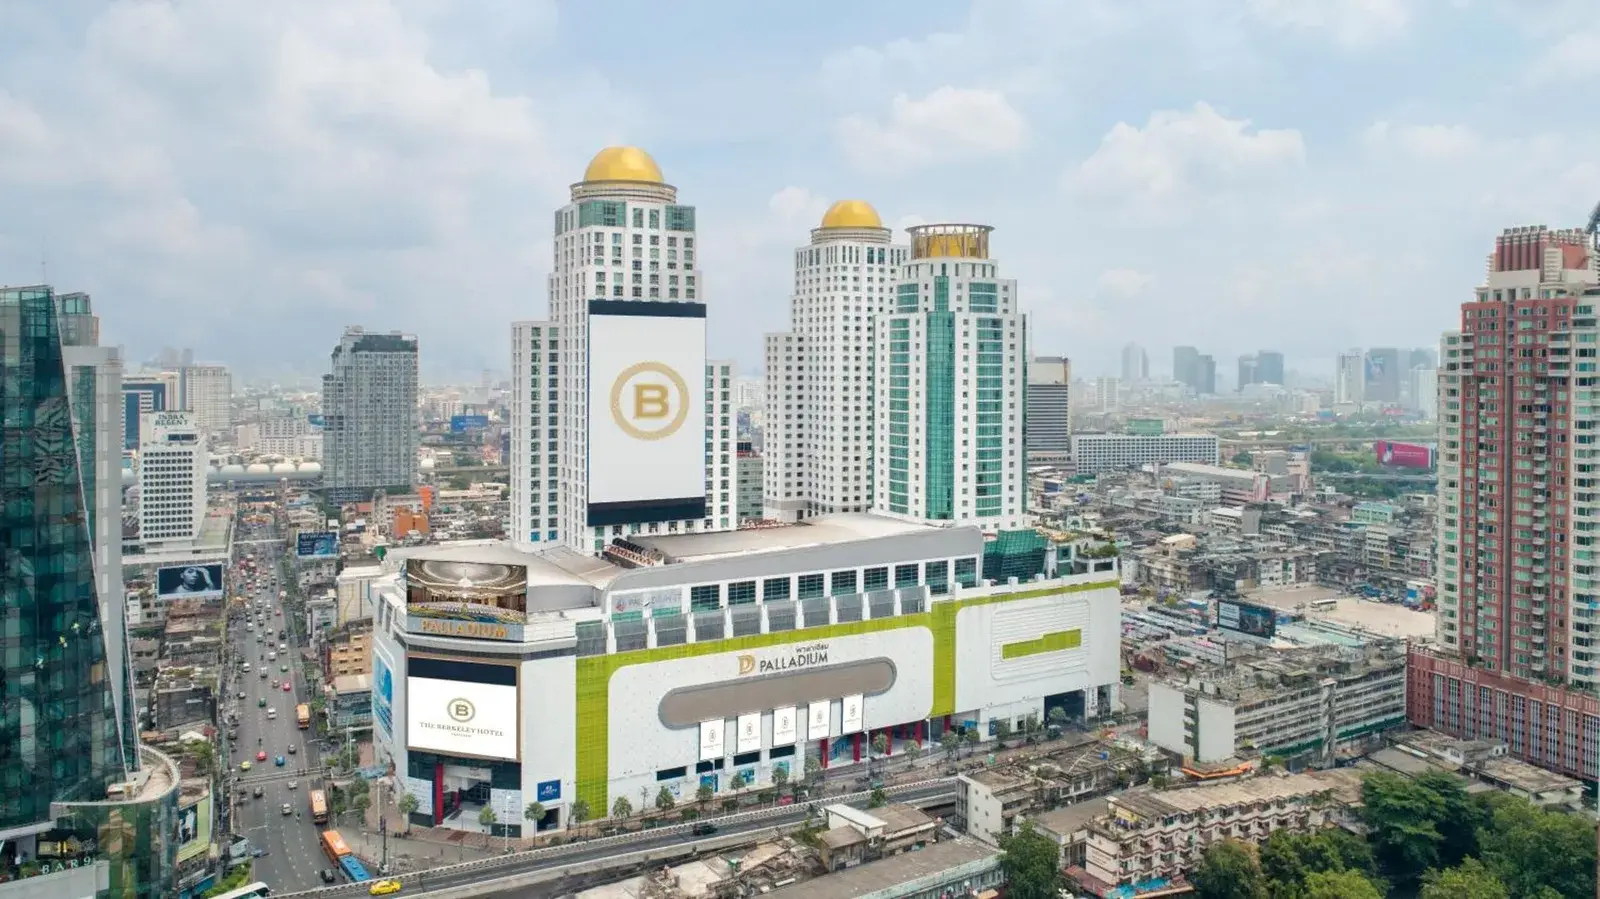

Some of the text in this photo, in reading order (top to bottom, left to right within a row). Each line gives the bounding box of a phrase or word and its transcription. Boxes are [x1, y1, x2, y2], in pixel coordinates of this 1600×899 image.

[634, 383, 669, 418] B
[760, 652, 828, 672] PALLADIUM
[455, 704, 469, 717] B
[437, 723, 476, 733] BERKELEY
[477, 728, 504, 737] HOTEL
